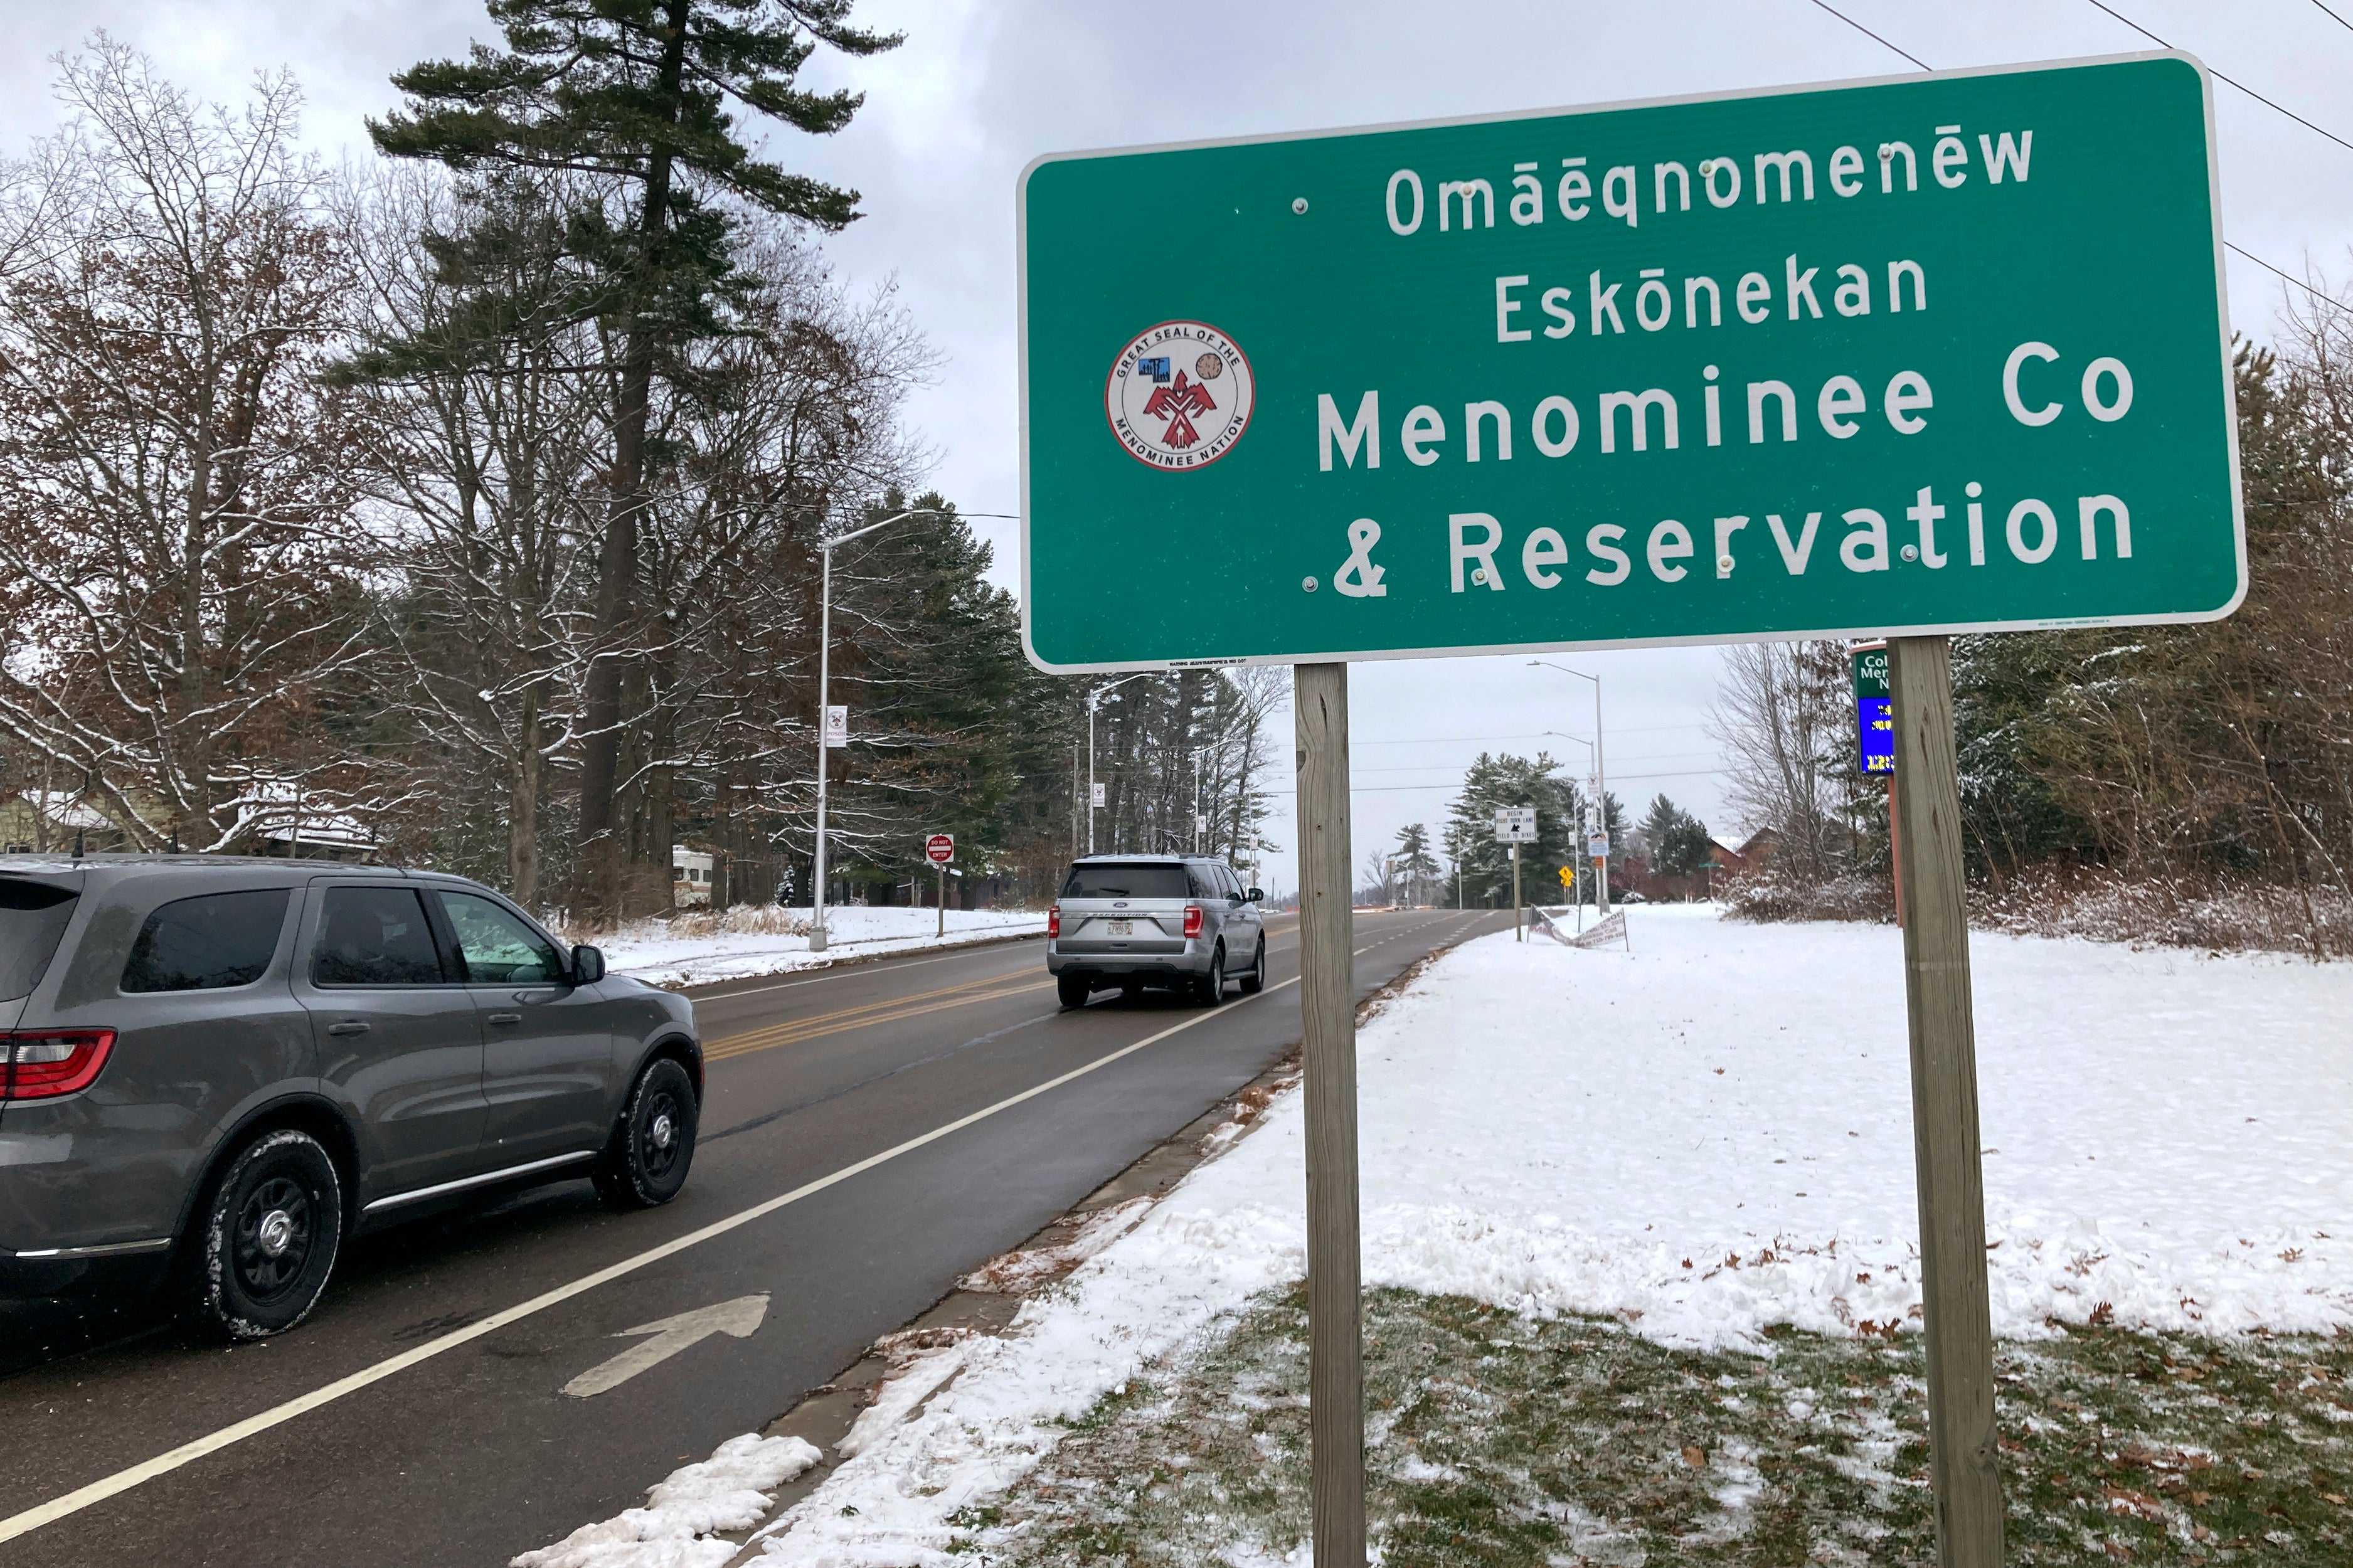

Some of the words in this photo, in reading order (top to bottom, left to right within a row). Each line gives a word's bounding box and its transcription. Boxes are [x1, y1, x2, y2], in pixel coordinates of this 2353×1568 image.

[1385, 125, 2034, 236] Omāēqnomenēw
[1495, 253, 1926, 343] Eskōnekan
[1117, 338, 1149, 378] GREAT
[1155, 327, 1190, 342] SEAL
[1197, 330, 1215, 342] OF
[1218, 341, 1241, 366] THE
[1115, 418, 1194, 466] MENOMINEE
[1199, 416, 1244, 462] NATION
[1317, 364, 1935, 472] Menominee
[2002, 341, 2134, 427] Co
[1332, 517, 1388, 598] &
[1448, 481, 2133, 594] Reservation
